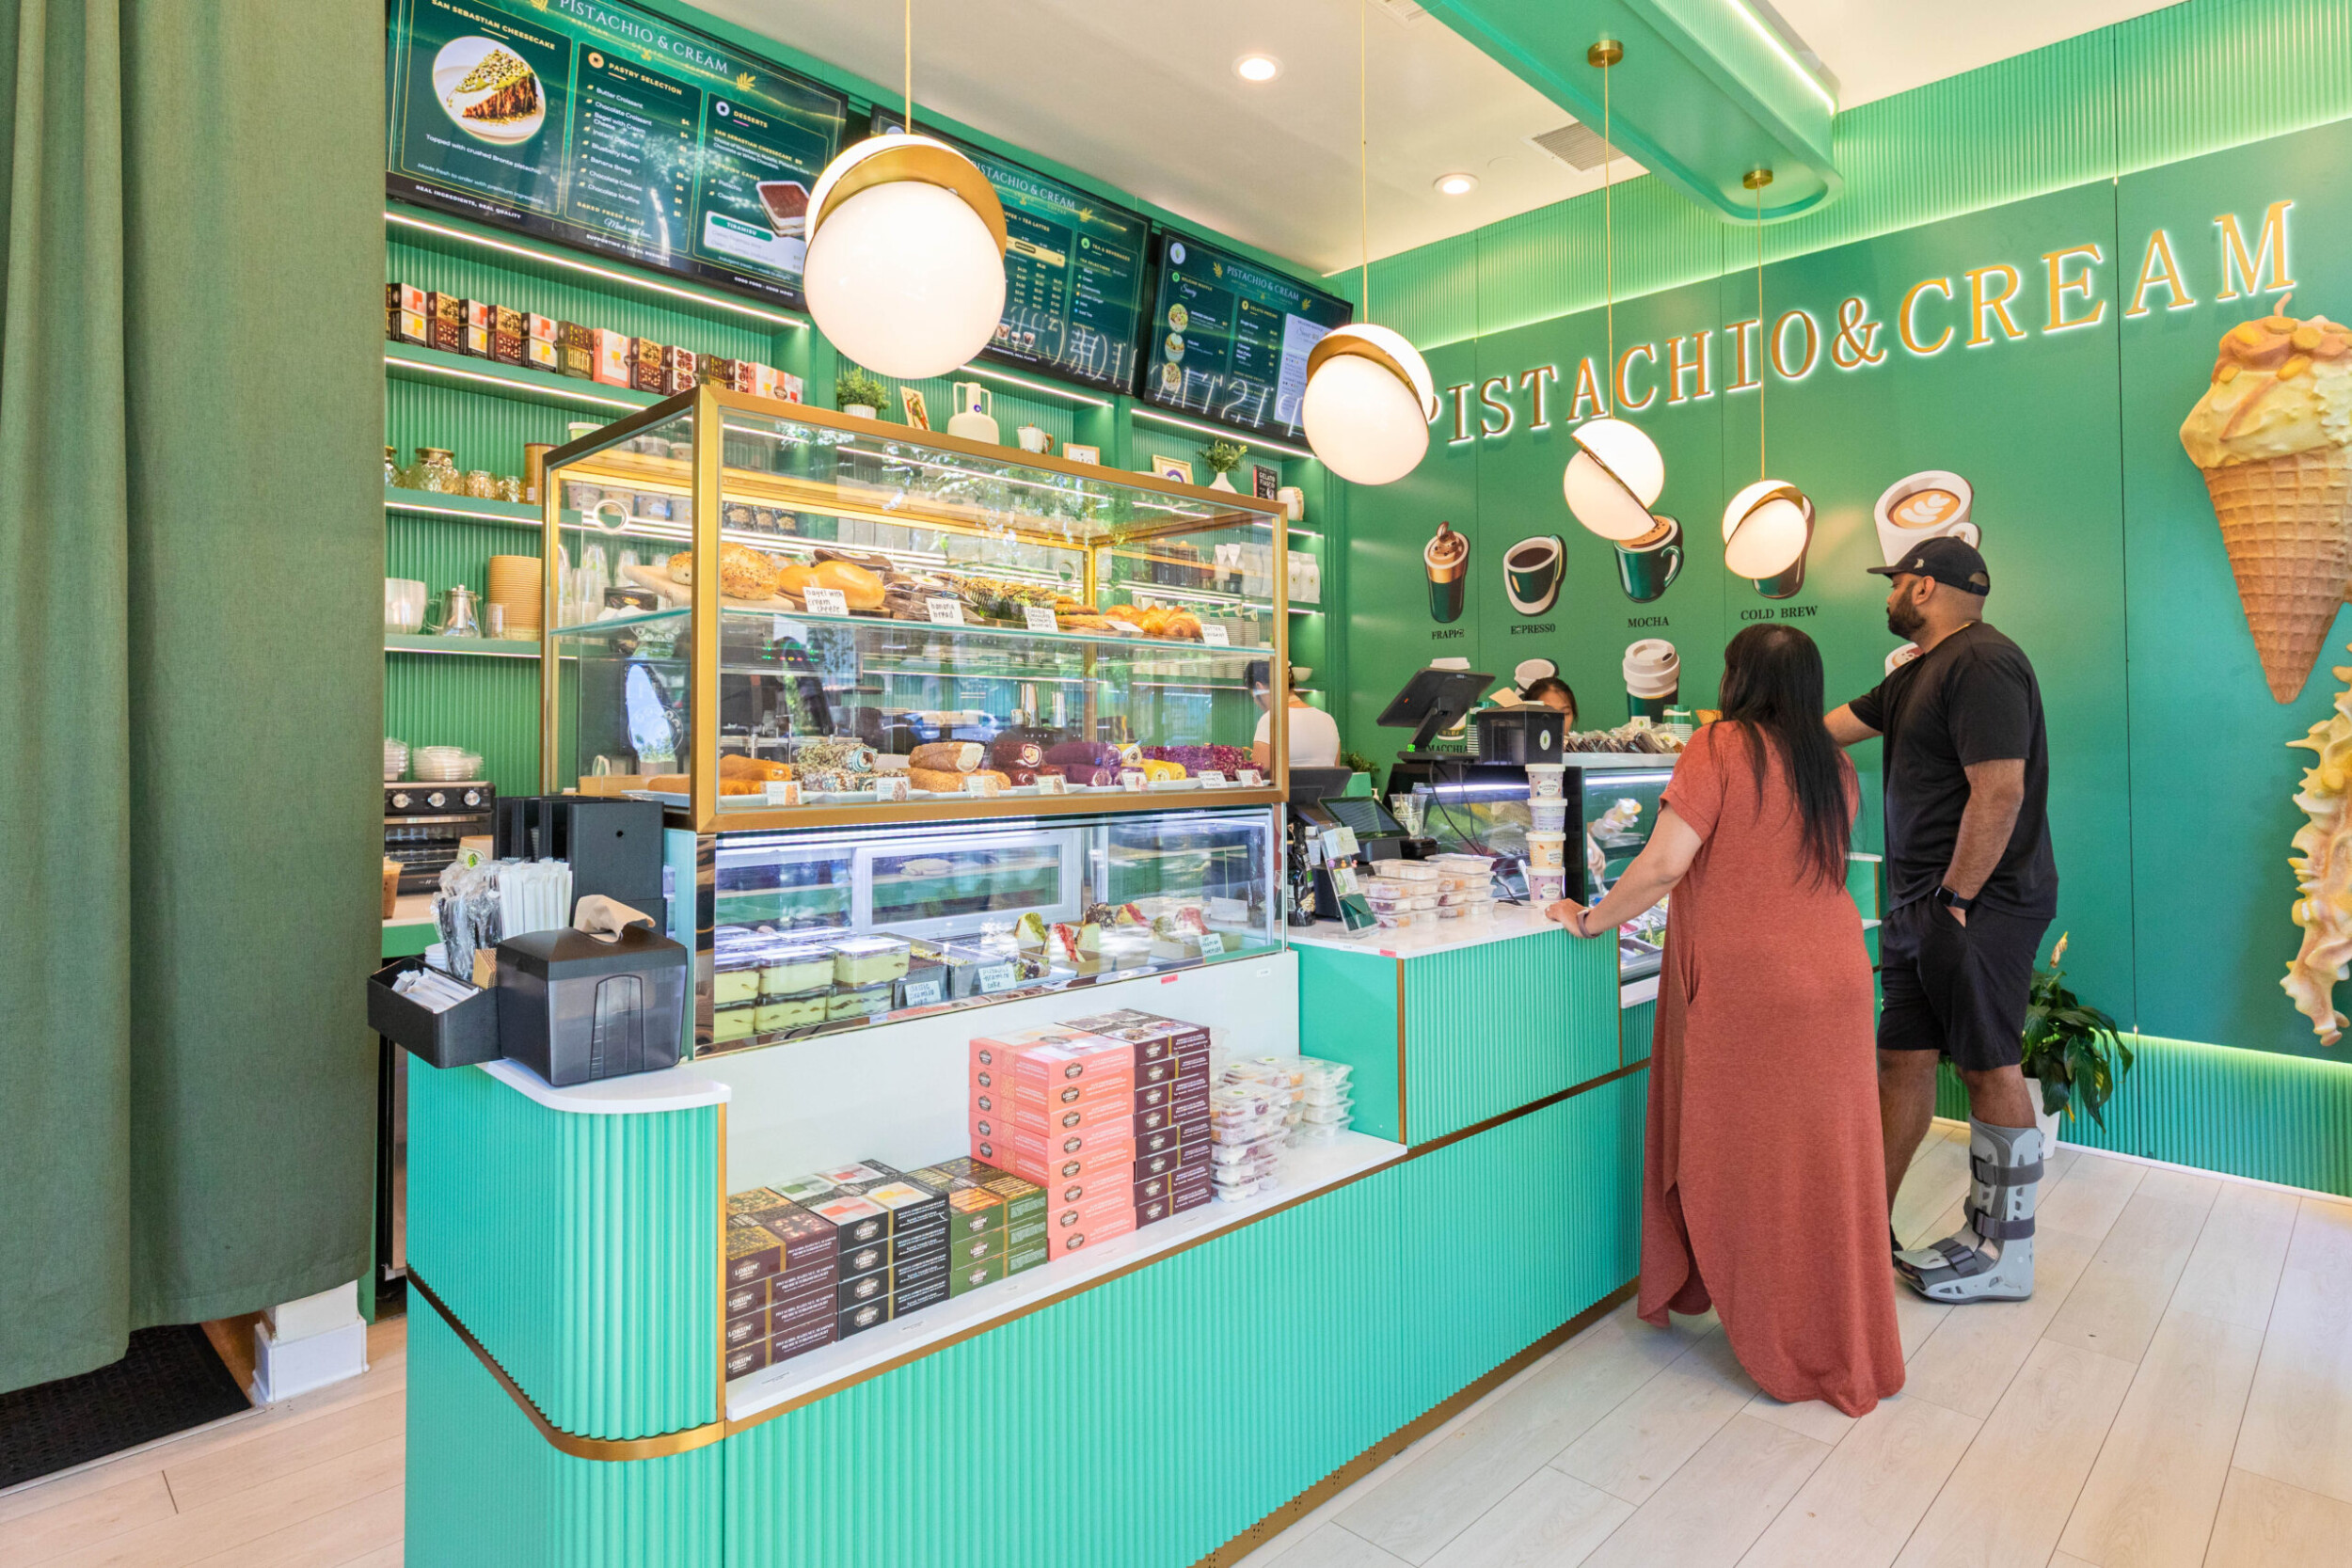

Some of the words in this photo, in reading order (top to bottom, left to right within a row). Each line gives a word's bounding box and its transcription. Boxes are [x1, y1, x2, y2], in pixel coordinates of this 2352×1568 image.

[431, 0, 450, 10] SAN
[453, 5, 501, 29] SEBASTIAN
[502, 24, 556, 50] CHEESECAKE
[560, 0, 654, 43] PISTACHIO
[658, 36, 669, 50] &
[673, 41, 728, 74] CREAM
[608, 62, 639, 78] PASTRY
[641, 75, 682, 95] SELECTION
[596, 87, 615, 99] Butter
[616, 95, 644, 109] Croissant
[595, 102, 625, 116] Chocolate
[626, 112, 652, 126] Croissant
[733, 110, 768, 128] DESSERTS
[594, 119, 615, 131] Cheese
[612, 117, 626, 127] with
[627, 123, 645, 135] Cream
[426, 134, 451, 147] Topped
[452, 141, 466, 150] with
[467, 147, 491, 159] crushed
[492, 154, 514, 166] Bronte
[592, 143, 621, 158] Blueberry
[621, 151, 640, 164] Muffin
[727, 133, 757, 149] SEBASTIAN
[758, 145, 792, 161] CHEESECAKE
[590, 156, 612, 169] Banana
[614, 164, 631, 175] Bread
[417, 163, 435, 172] Made
[436, 166, 451, 177] fresh
[458, 175, 473, 183] order
[474, 179, 486, 187] with
[487, 183, 514, 196] premium
[589, 170, 618, 184] Chocolate
[619, 180, 642, 192] Cookies
[741, 171, 760, 181] CAKES
[588, 183, 617, 198] Chocolate
[1031, 184, 1038, 196] &
[1040, 189, 1075, 210] CREAM
[416, 184, 433, 195] REAL
[434, 190, 478, 207] INGREDIENTS,
[479, 202, 494, 212] REAL
[496, 208, 521, 219] QUALITY
[726, 221, 757, 236] TIRAMISU
[1023, 215, 1032, 225] TEA
[1033, 219, 1050, 232] LATTES
[586, 234, 620, 247] SUPPORTING
[627, 245, 644, 256] LOCAL
[1105, 248, 1130, 261] BEVERAGES
[1227, 265, 1267, 288] PISTACHIO
[1274, 285, 1298, 300] CREAM
[1428, 198, 2296, 444] ISTACHIO&CREAM
[930, 602, 955, 610] banana
[1740, 609, 1774, 621] COLD
[1780, 606, 1819, 618] BREW
[933, 610, 954, 619] bread
[1628, 616, 1669, 628] MOCHA
[1511, 623, 1556, 635] ESPRESSO
[1426, 744, 1468, 753] MACCHIA
[856, 1225, 877, 1235] LOKUM
[855, 1254, 876, 1264] LOKUM
[735, 1261, 759, 1275] LOKUM
[856, 1282, 877, 1293] LOKUM
[728, 1293, 753, 1308] LOKUM
[856, 1311, 877, 1322] LOKUM
[728, 1324, 752, 1338] LOKUM
[728, 1354, 753, 1369] LOKUM
